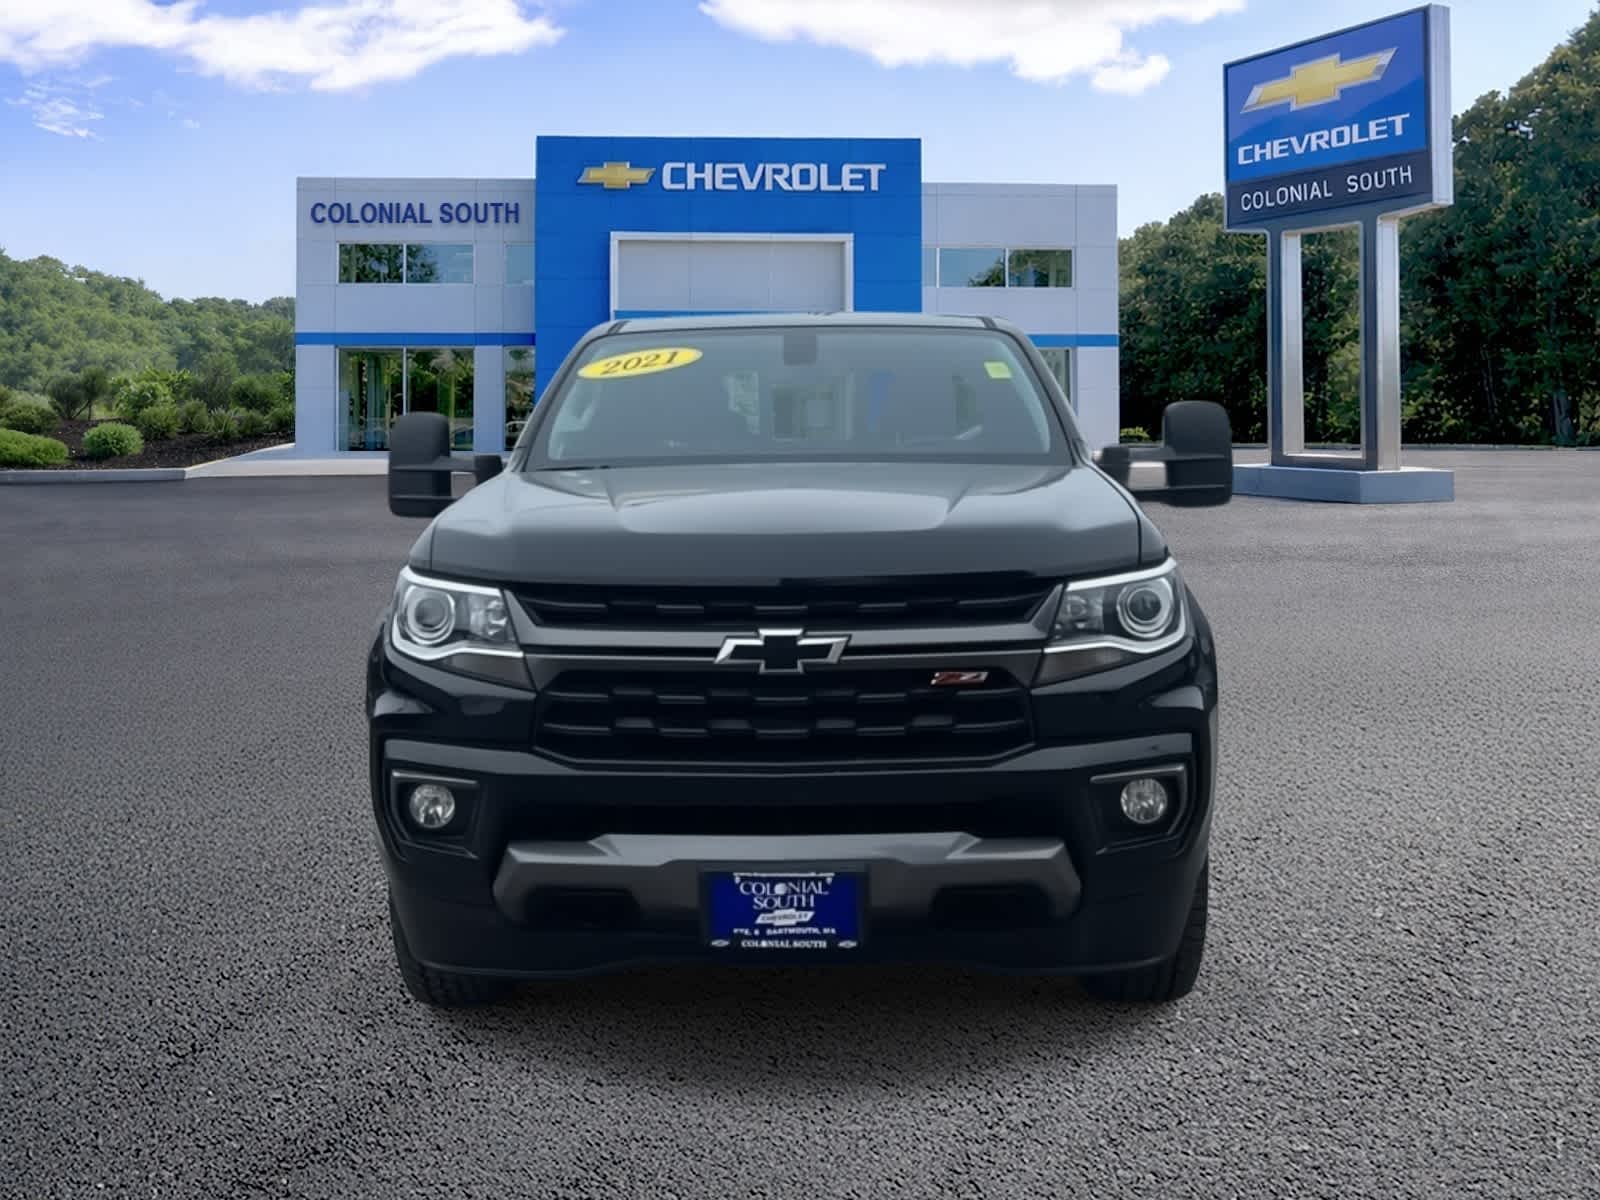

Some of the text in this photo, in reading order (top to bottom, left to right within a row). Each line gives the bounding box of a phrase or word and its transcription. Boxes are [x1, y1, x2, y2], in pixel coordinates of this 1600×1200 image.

[1237, 113, 1411, 165] CHEVROLET
[662, 162, 887, 192] CHEVROLET
[1241, 165, 1413, 212] COLONIAL SOUTH
[310, 202, 520, 225] COLONIAL SOUTH
[601, 351, 678, 375] 2021
[739, 881, 829, 895] COLONIAL
[753, 894, 815, 910] SOUTH
[741, 940, 793, 949] COLONIAL
